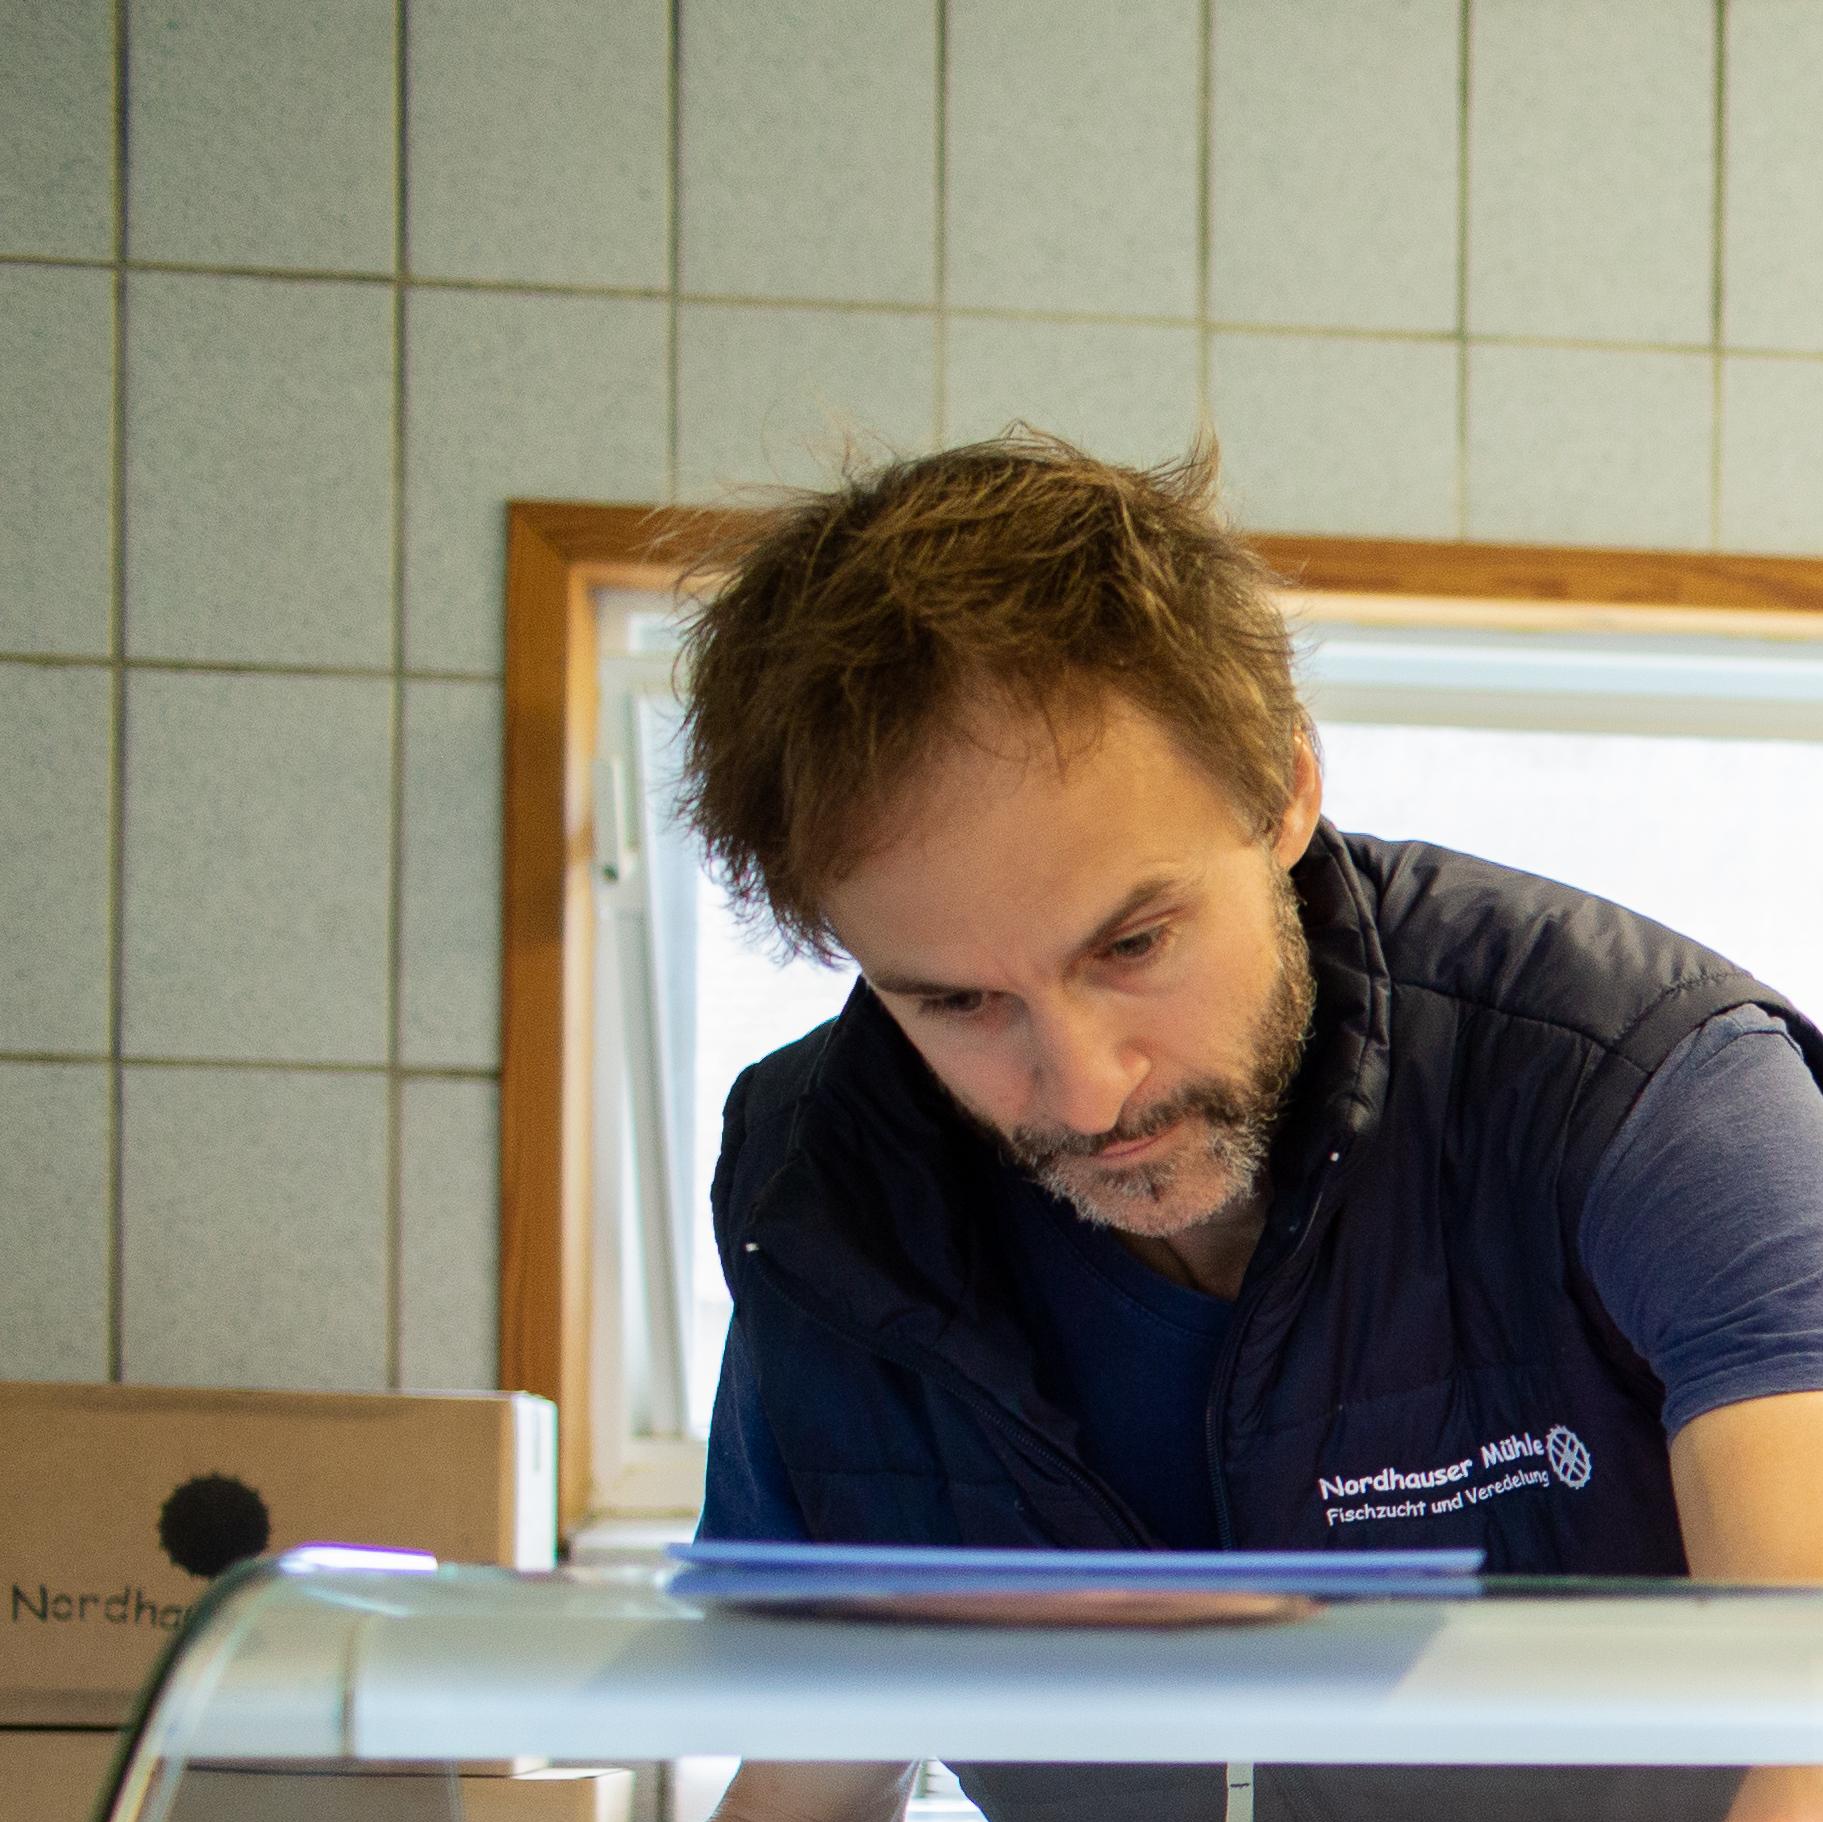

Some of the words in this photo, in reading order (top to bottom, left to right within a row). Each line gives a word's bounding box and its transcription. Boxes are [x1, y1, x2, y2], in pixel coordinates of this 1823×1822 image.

[1317, 1458, 1473, 1501] Nordhauser
[1480, 1431, 1545, 1469] Mühle
[1325, 1500, 1427, 1527] Fischzucht
[1431, 1493, 1464, 1515] und
[1466, 1469, 1550, 1505] Veredelung
